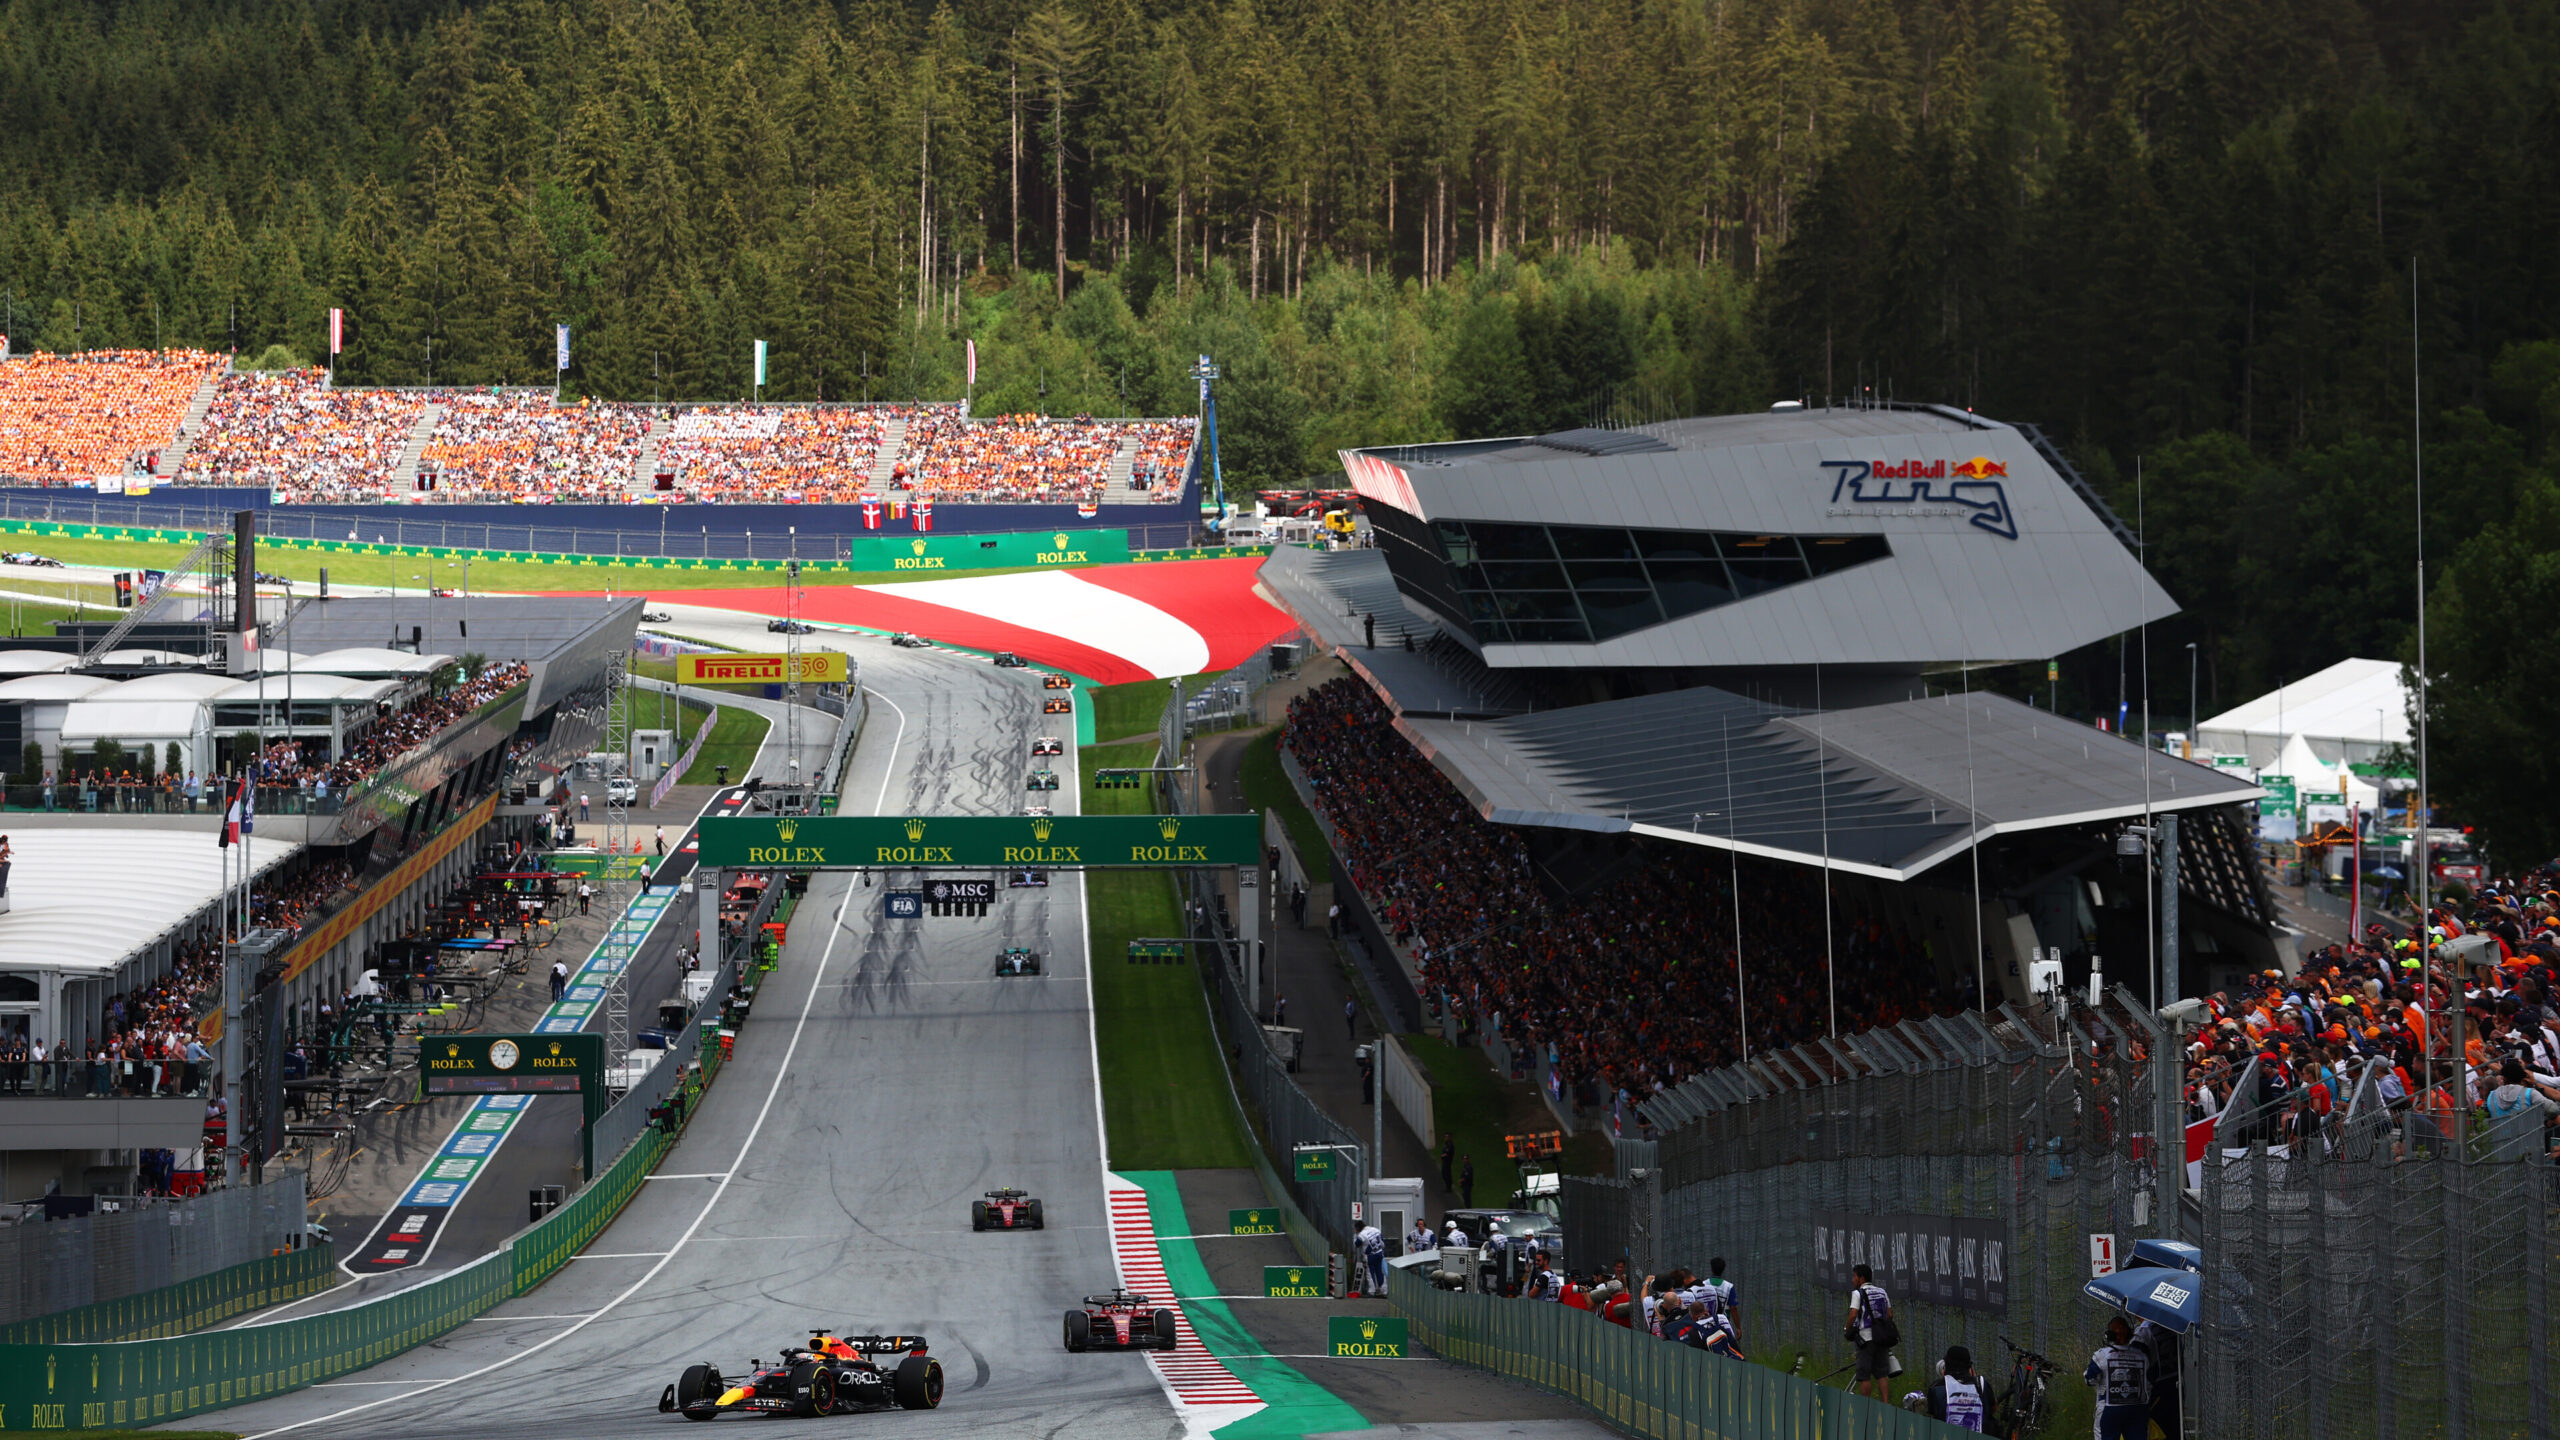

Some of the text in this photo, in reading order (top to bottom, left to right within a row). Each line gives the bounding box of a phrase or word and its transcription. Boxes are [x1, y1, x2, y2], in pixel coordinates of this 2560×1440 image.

[1872, 459, 1946, 478] Red Bull
[1820, 461, 2018, 540] Ring
[894, 557, 945, 568] ROLEX
[1036, 550, 1088, 564] ROLEX
[695, 658, 782, 678] PIRELLI
[750, 847, 825, 862] ROLEX
[877, 847, 953, 862] ROLEX
[1005, 846, 1081, 862] ROLEX
[1132, 846, 1207, 861] ROLEX
[952, 884, 988, 896] MSC
[431, 1057, 577, 1069] ROLEX ROLEX
[1234, 1225, 1275, 1235] ROLEX
[1271, 1286, 1319, 1297] ROLEX
[1337, 1343, 1399, 1357] ROLEX
[839, 1371, 882, 1385] ORACLE
[32, 1404, 65, 1428] ROLEX
[83, 1403, 105, 1427] ROLEX
